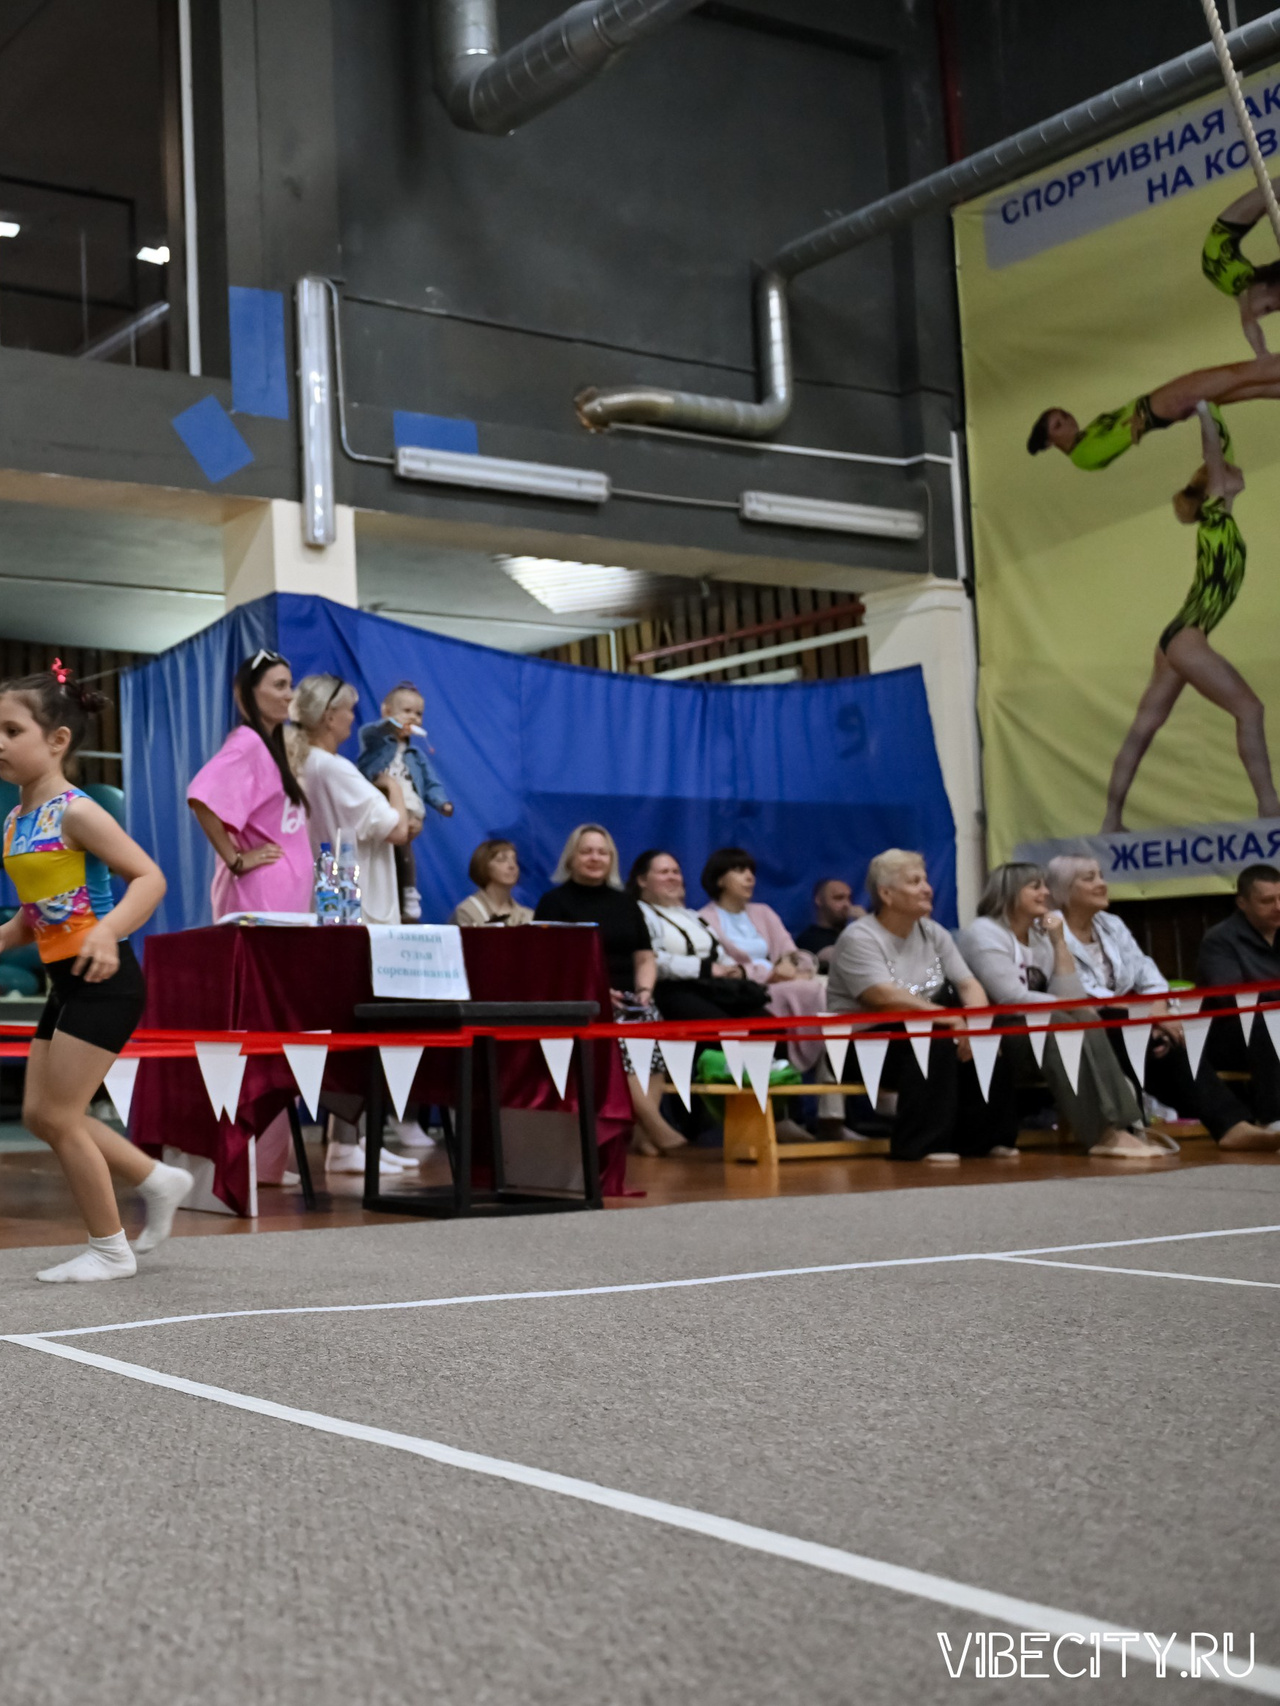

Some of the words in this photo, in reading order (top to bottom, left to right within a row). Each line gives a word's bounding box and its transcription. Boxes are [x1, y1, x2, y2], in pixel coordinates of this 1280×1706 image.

[1001, 108, 1226, 225] СПОРТИВНАЯ
[1146, 165, 1194, 204] НА
[1205, 128, 1278, 181] КОВ
[1110, 829, 1280, 872] ЖЕНСКАЯ
